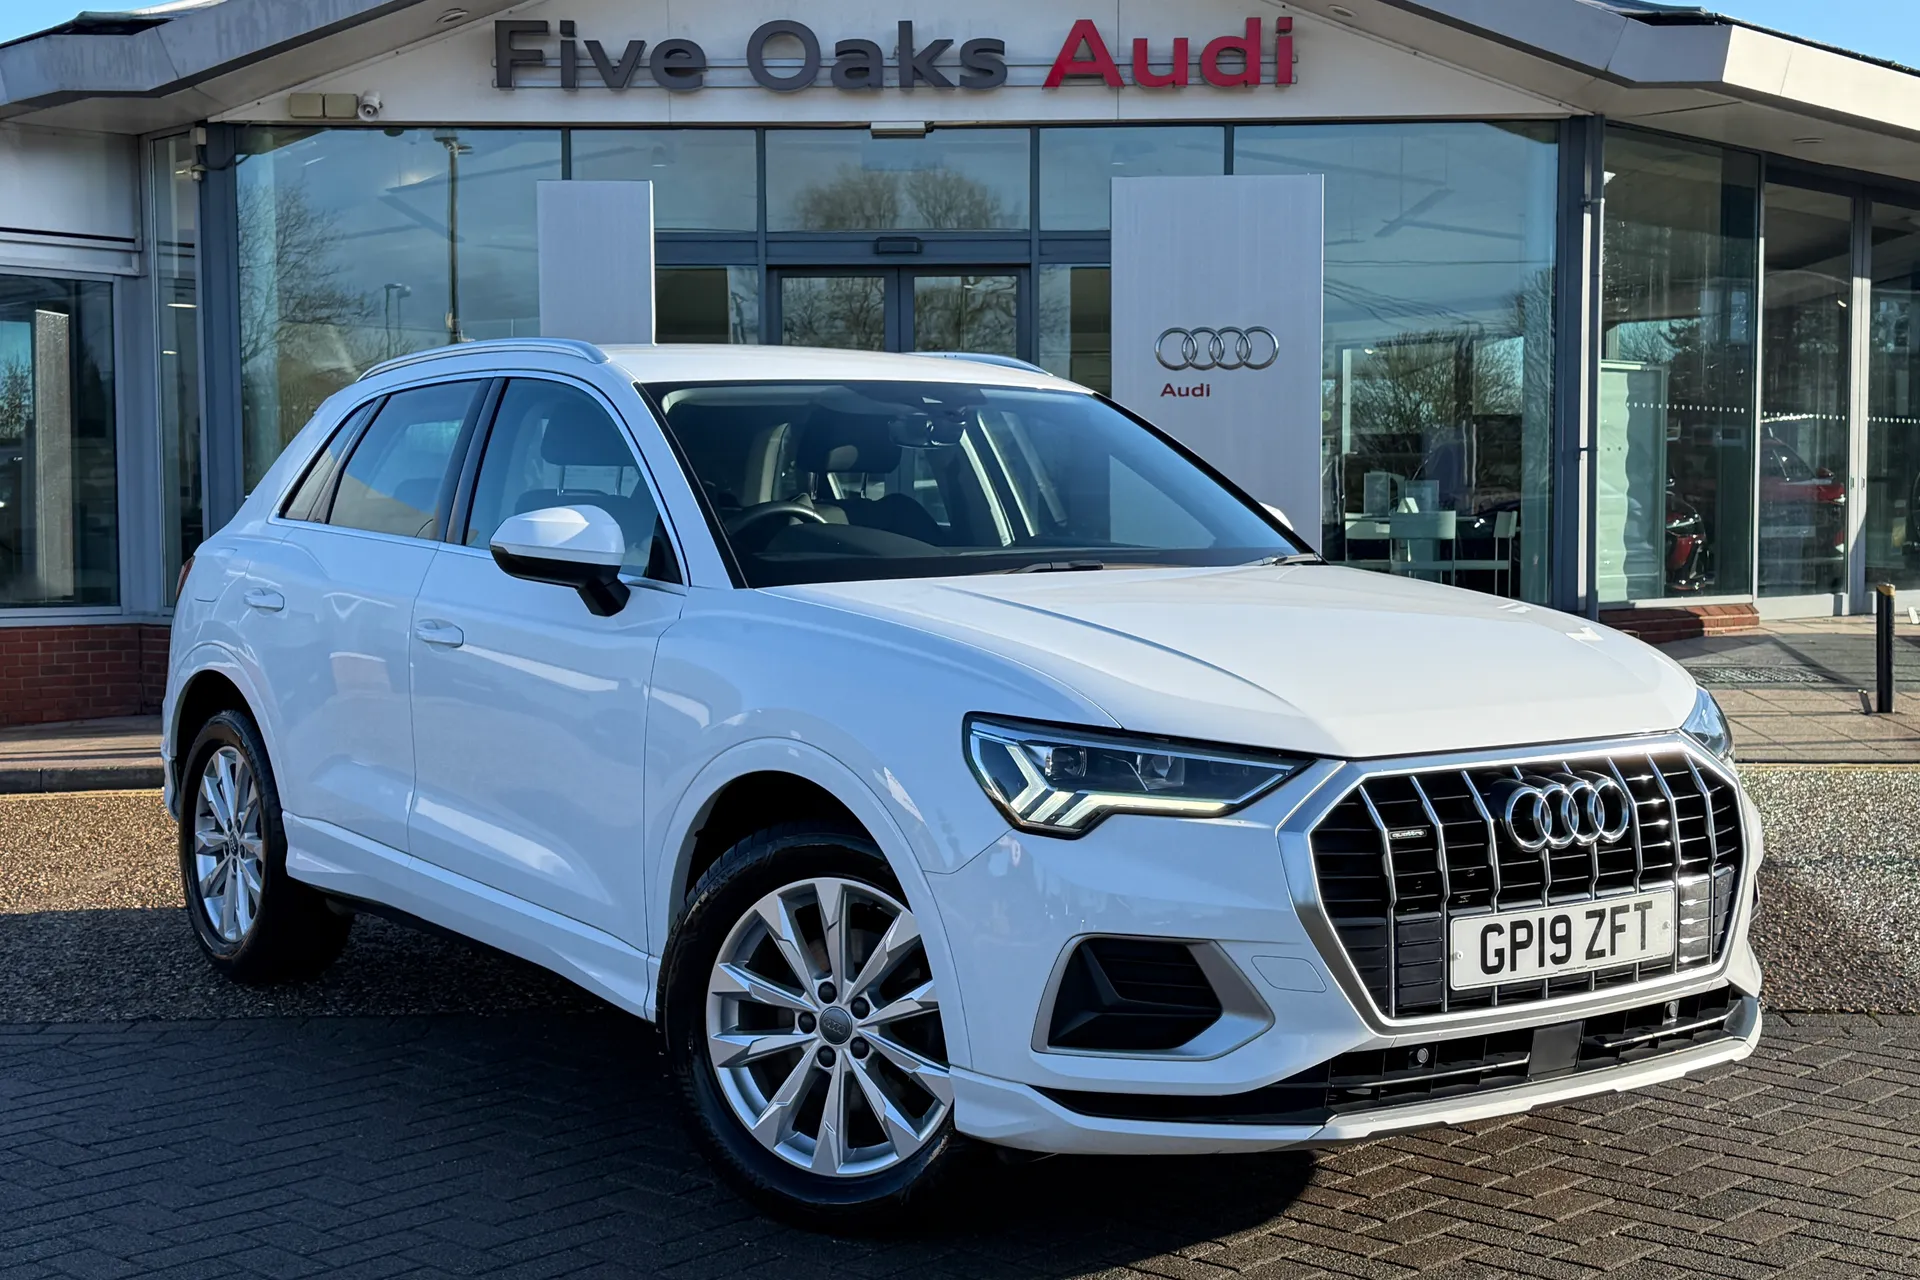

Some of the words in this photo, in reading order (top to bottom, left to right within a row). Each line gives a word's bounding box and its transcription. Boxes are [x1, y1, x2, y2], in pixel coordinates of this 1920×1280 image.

[494, 20, 706, 91] Five
[746, 19, 1007, 91] Oaks
[1042, 16, 1294, 88] Audi
[1160, 382, 1211, 398] Audi
[1480, 914, 1572, 976] GP19
[1585, 901, 1653, 961] ZFT
